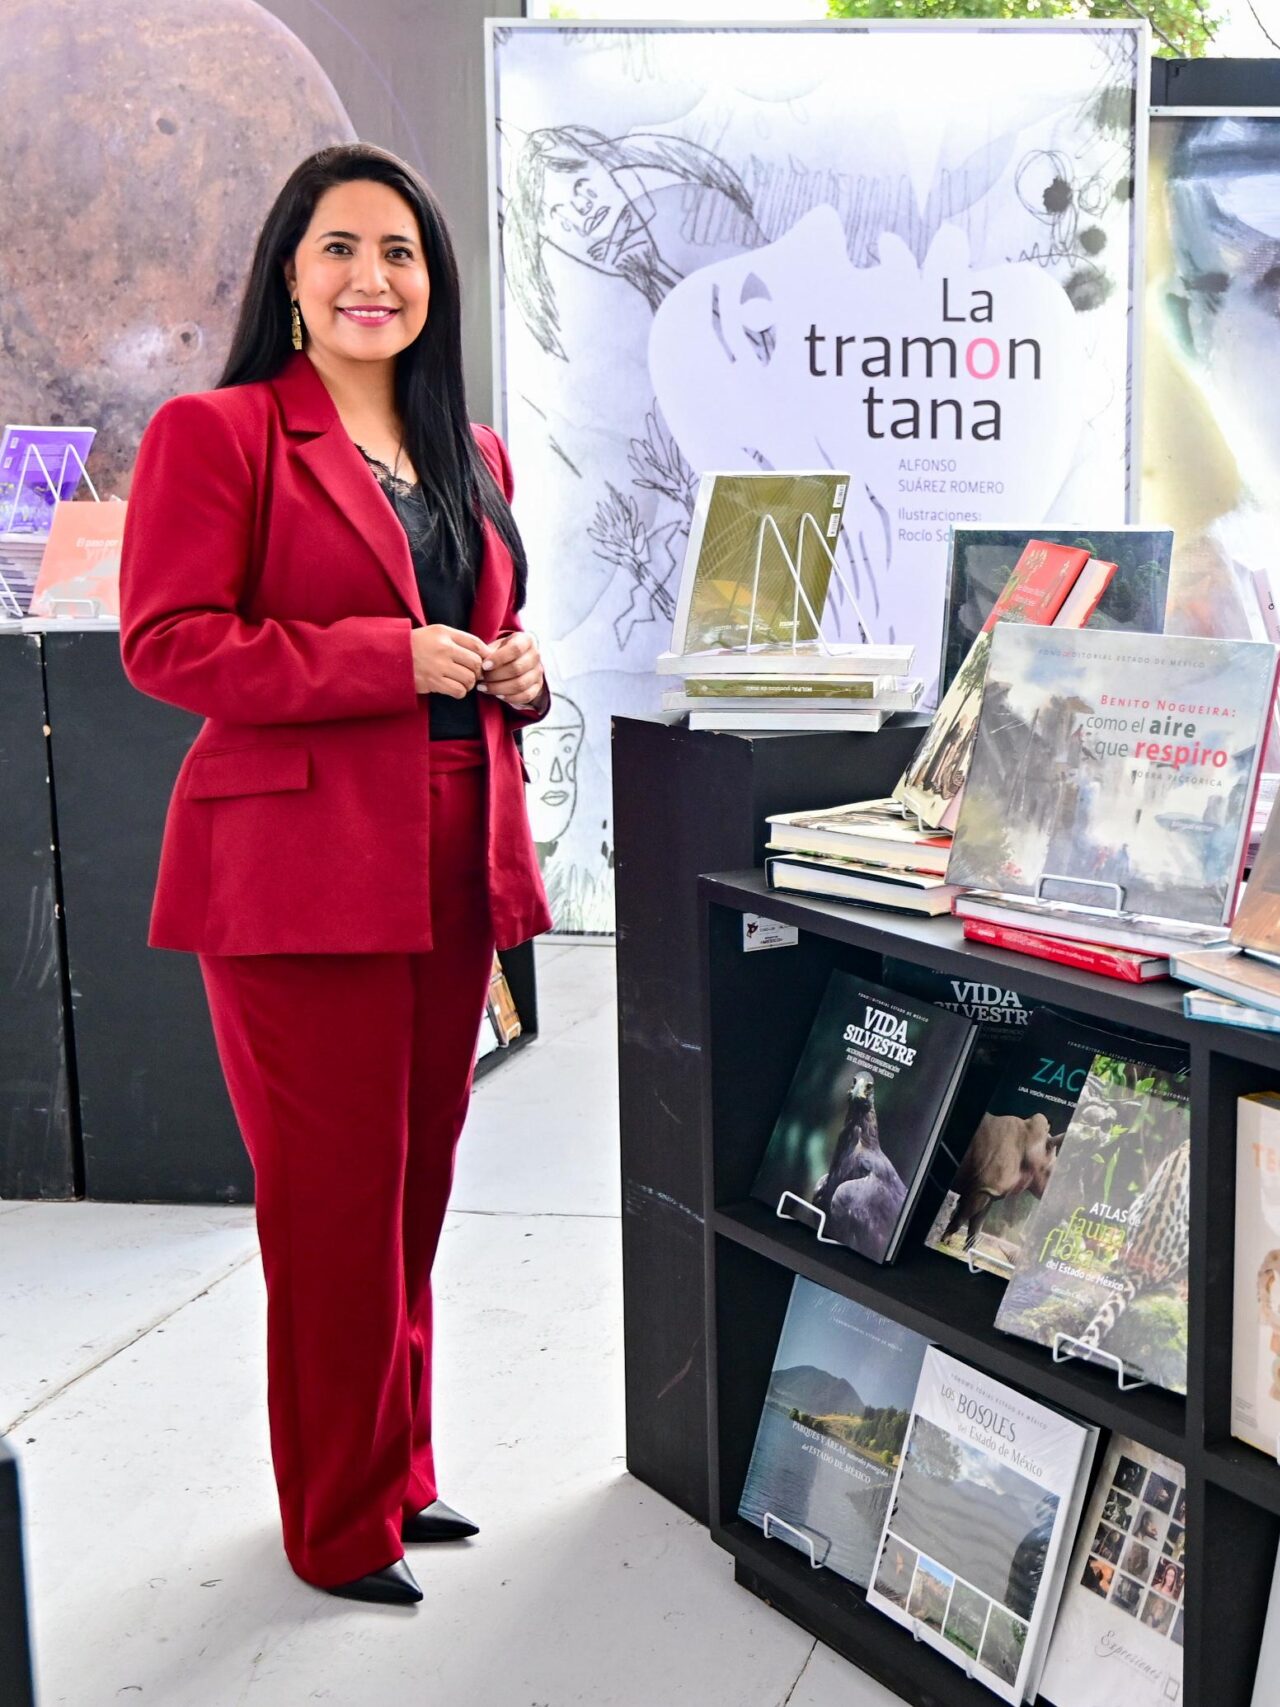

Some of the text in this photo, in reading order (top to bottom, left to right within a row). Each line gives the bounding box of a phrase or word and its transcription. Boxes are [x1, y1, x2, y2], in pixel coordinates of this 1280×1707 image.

[942, 278, 993, 323] La
[804, 324, 1041, 380] tramon
[863, 386, 1001, 441] tana
[898, 458, 957, 472] ALFONSO
[898, 478, 1005, 494] SUÁREZ ROMERO
[898, 506, 983, 522] Ilustraciones:
[898, 528, 935, 542] Rocío
[1086, 715, 1197, 739] como el aire
[1094, 739, 1228, 771] que respiro
[950, 980, 1023, 1008] VIDA
[864, 1005, 909, 1045] VIDA
[843, 1023, 917, 1067] SILVESTRE
[1062, 1206, 1126, 1246] fauna
[1089, 1202, 1129, 1224] ATLAS
[1038, 1227, 1095, 1268] flora
[1046, 1259, 1060, 1271] del
[1058, 1262, 1085, 1279] Estado
[1095, 1273, 1125, 1292] México
[940, 1383, 1017, 1443] LOS BOSQUES
[792, 1420, 821, 1441] PARQUES
[808, 1445, 835, 1465] ESTADO
[833, 1459, 844, 1471] DE
[969, 1425, 997, 1452] Estado
[998, 1442, 1010, 1458] de
[1011, 1448, 1043, 1479] México
